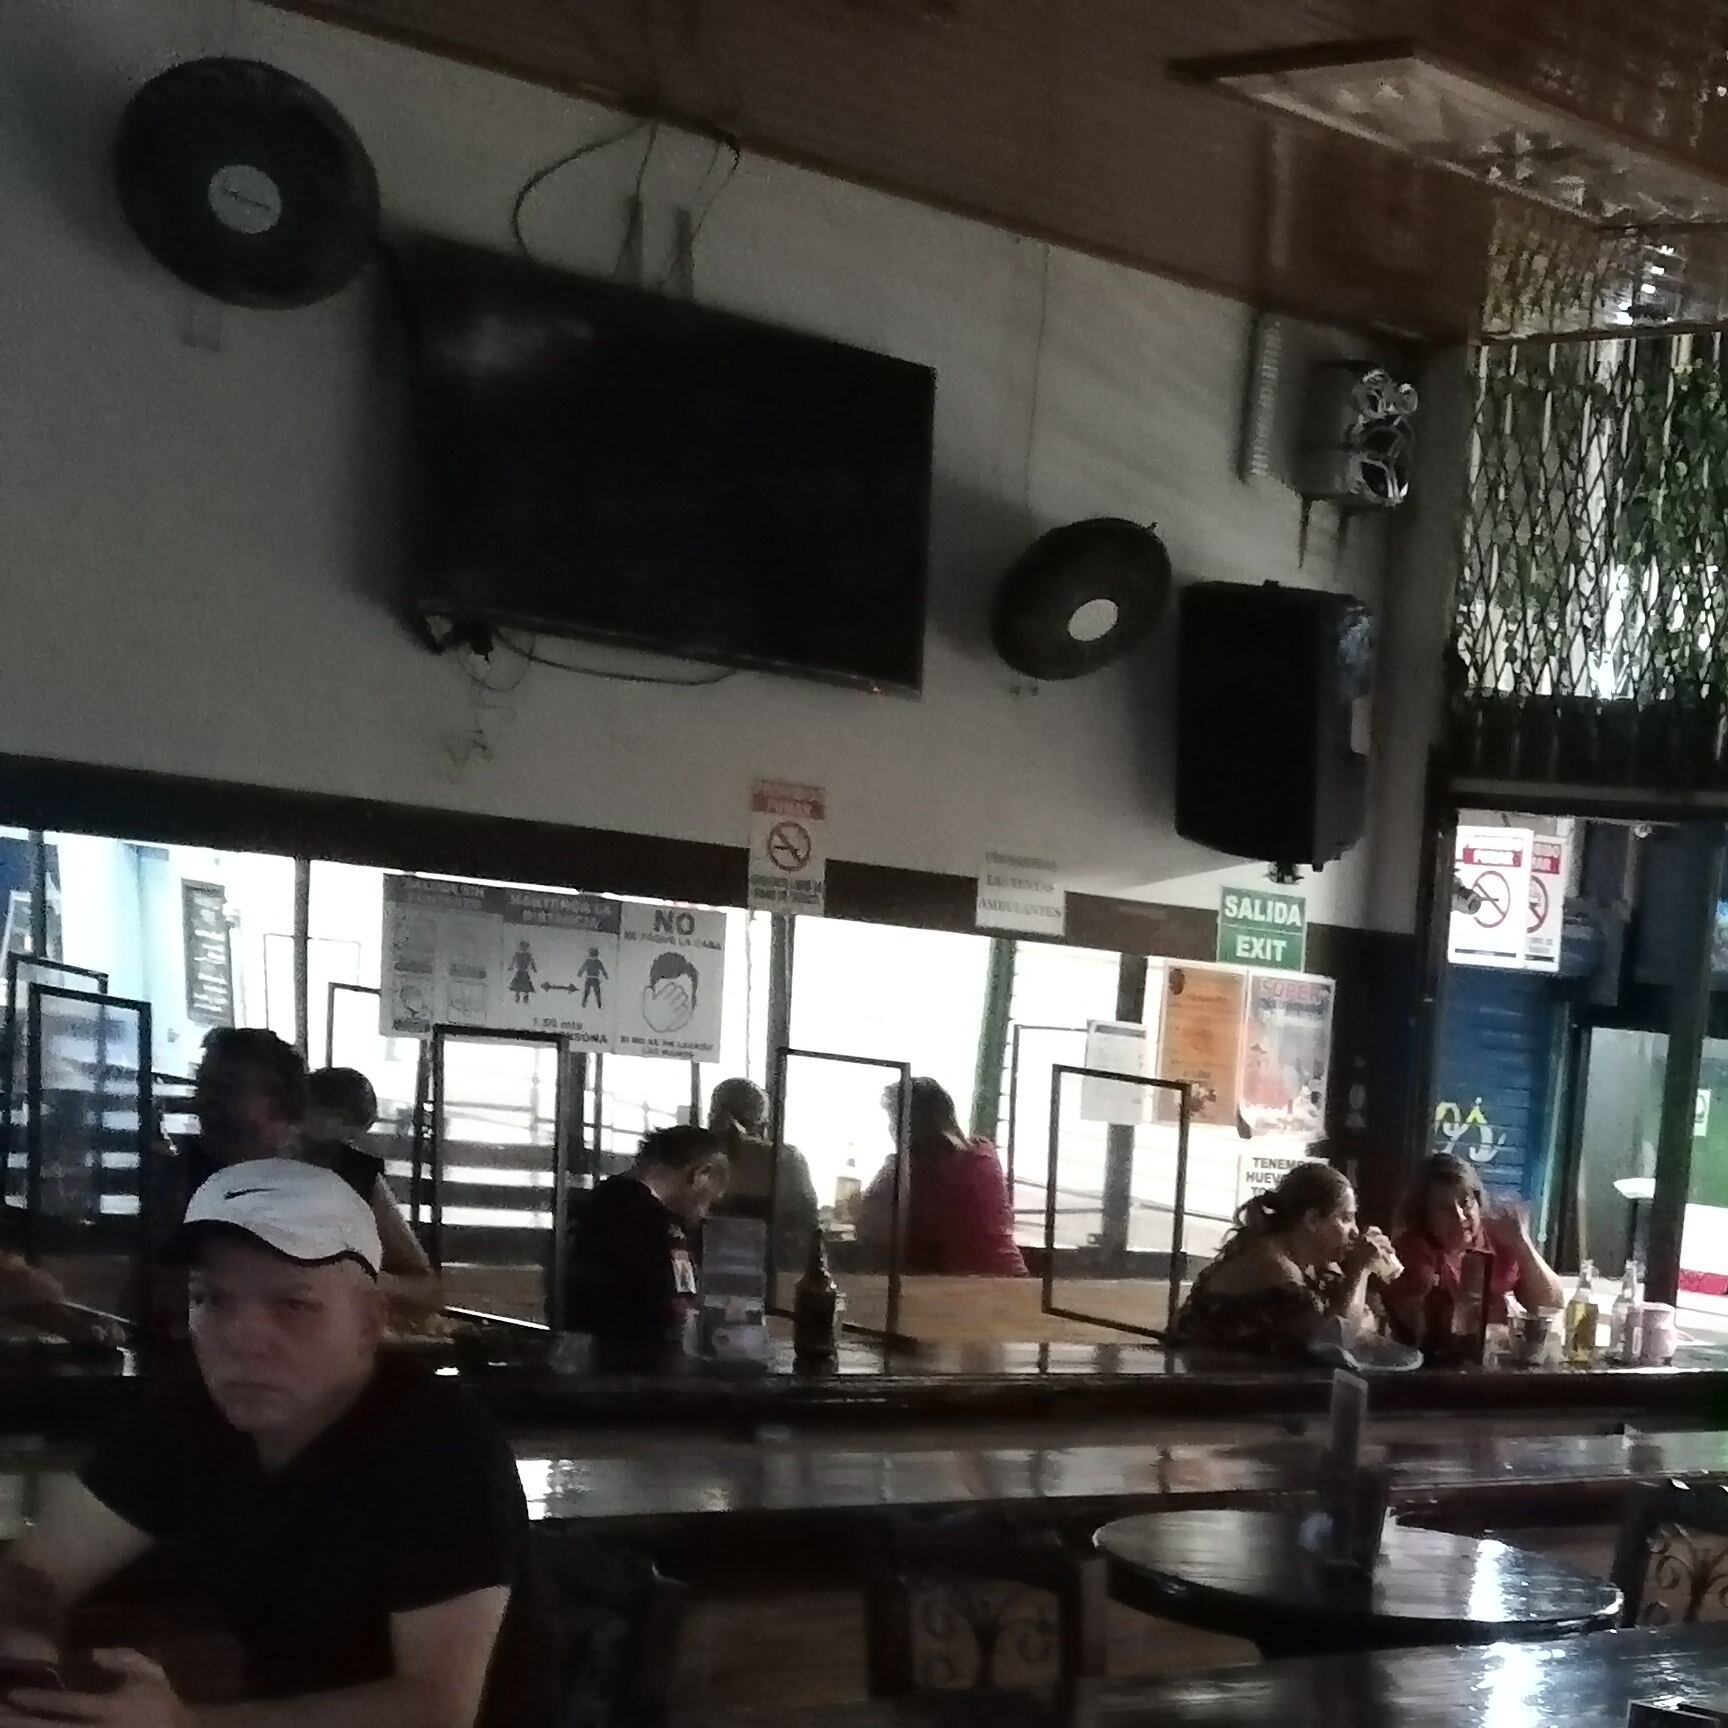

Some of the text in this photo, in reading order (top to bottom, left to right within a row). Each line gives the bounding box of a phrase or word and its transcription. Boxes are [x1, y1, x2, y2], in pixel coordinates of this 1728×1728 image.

[653, 909, 696, 936] NO
[1224, 895, 1302, 927] SALIDA
[1236, 935, 1287, 961] EXIT
[1246, 1172, 1285, 1184] HUEV
